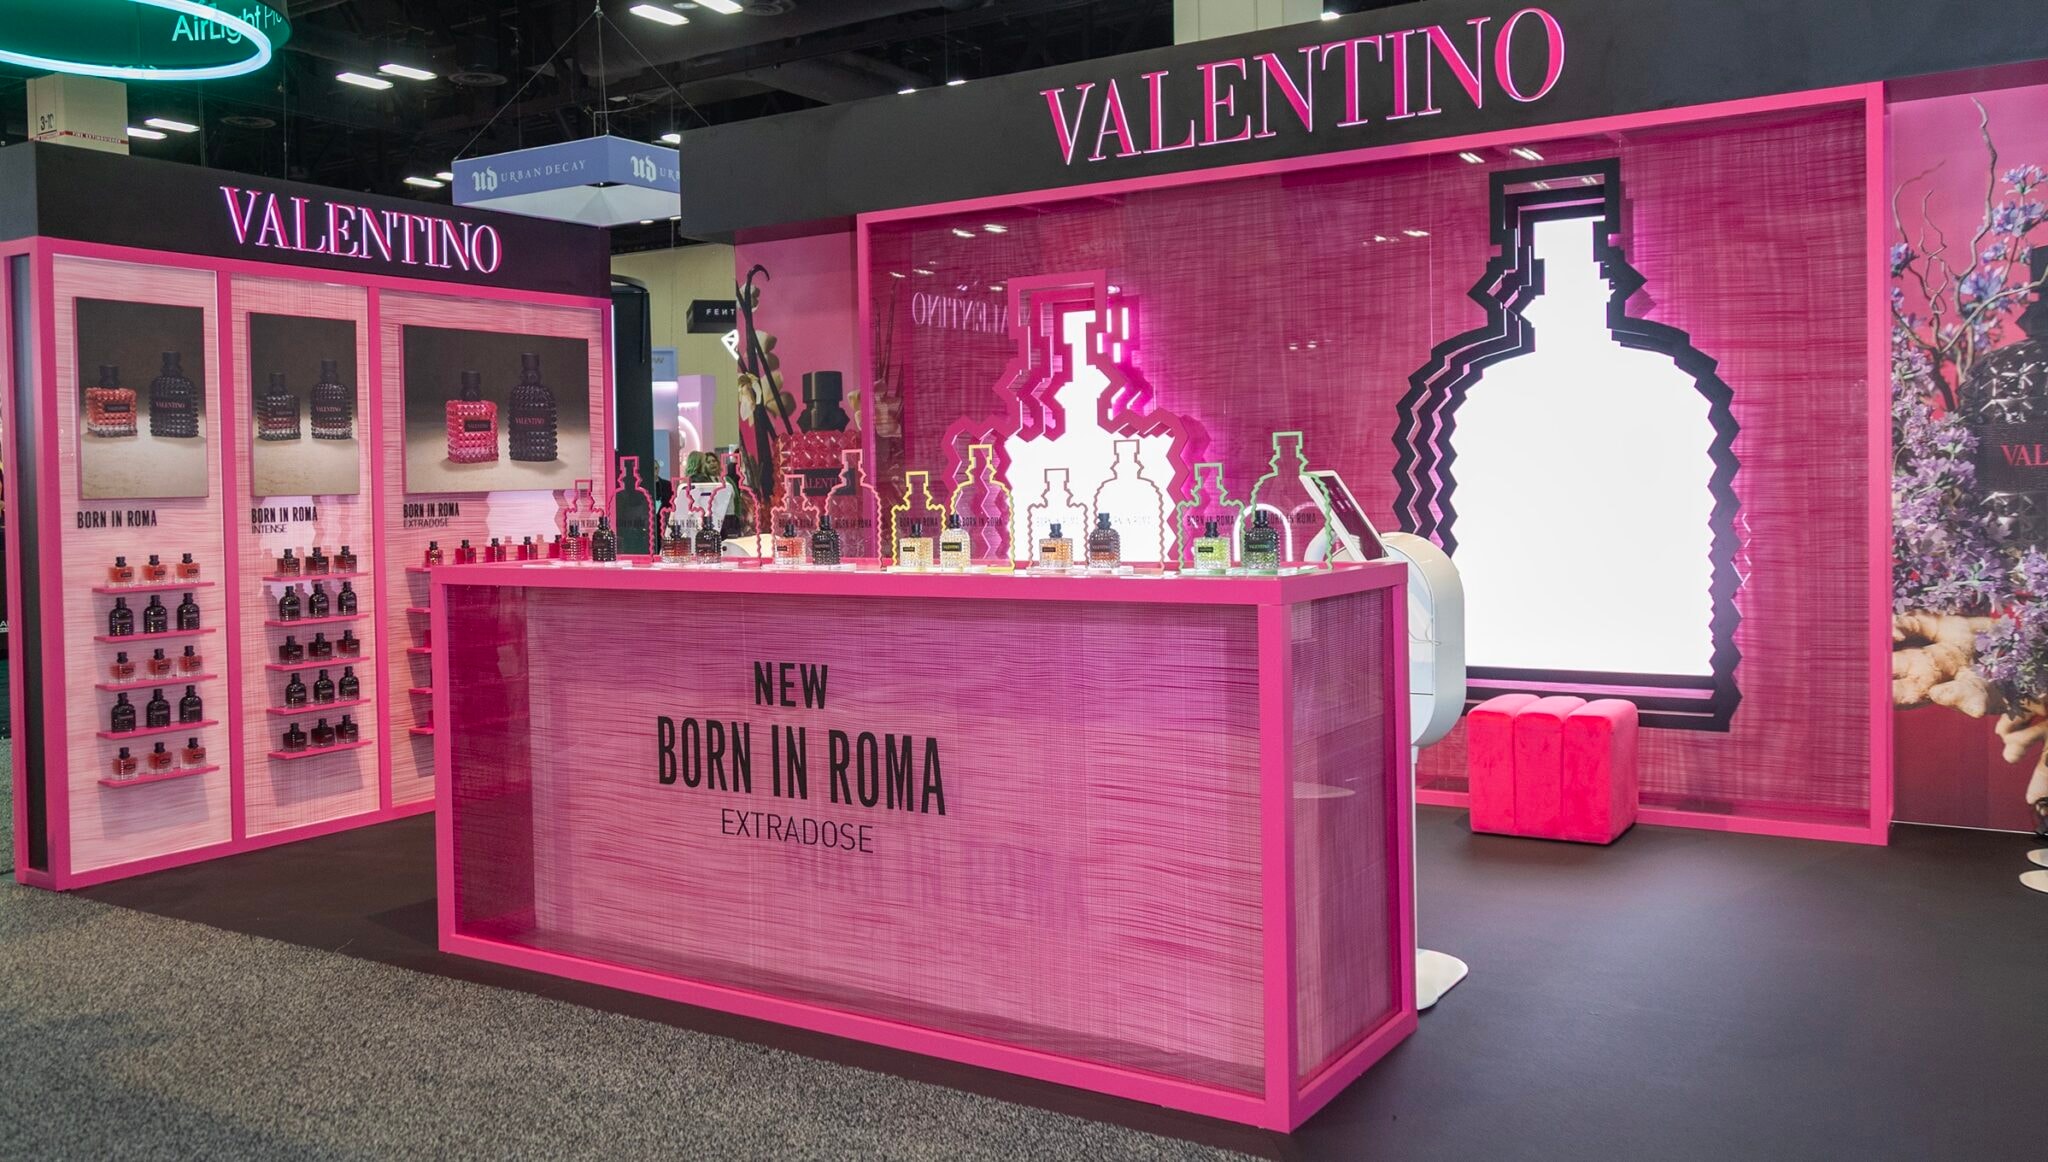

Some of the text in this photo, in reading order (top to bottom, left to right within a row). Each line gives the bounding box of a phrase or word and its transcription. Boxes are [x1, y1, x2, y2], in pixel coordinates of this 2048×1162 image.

[1040, 7, 1566, 167] VALENTINO
[501, 167, 542, 184] URBAN
[545, 159, 586, 176] DECAY
[219, 186, 502, 275] VALENTINO
[514, 417, 545, 425] VALENTINO
[2001, 443, 2048, 466] VAL
[77, 510, 158, 529] BORN IN ROMA
[251, 506, 318, 524] BORN IN ROMA
[403, 502, 460, 518] BORN IN ROMA
[1297, 513, 1316, 524] ROMA
[251, 524, 288, 534] INTENSE
[403, 518, 449, 529] EXTRADOSE
[753, 660, 828, 710] NEW
[657, 715, 946, 816] BORN IN ROMA
[721, 807, 874, 854] EXTRADOSE
